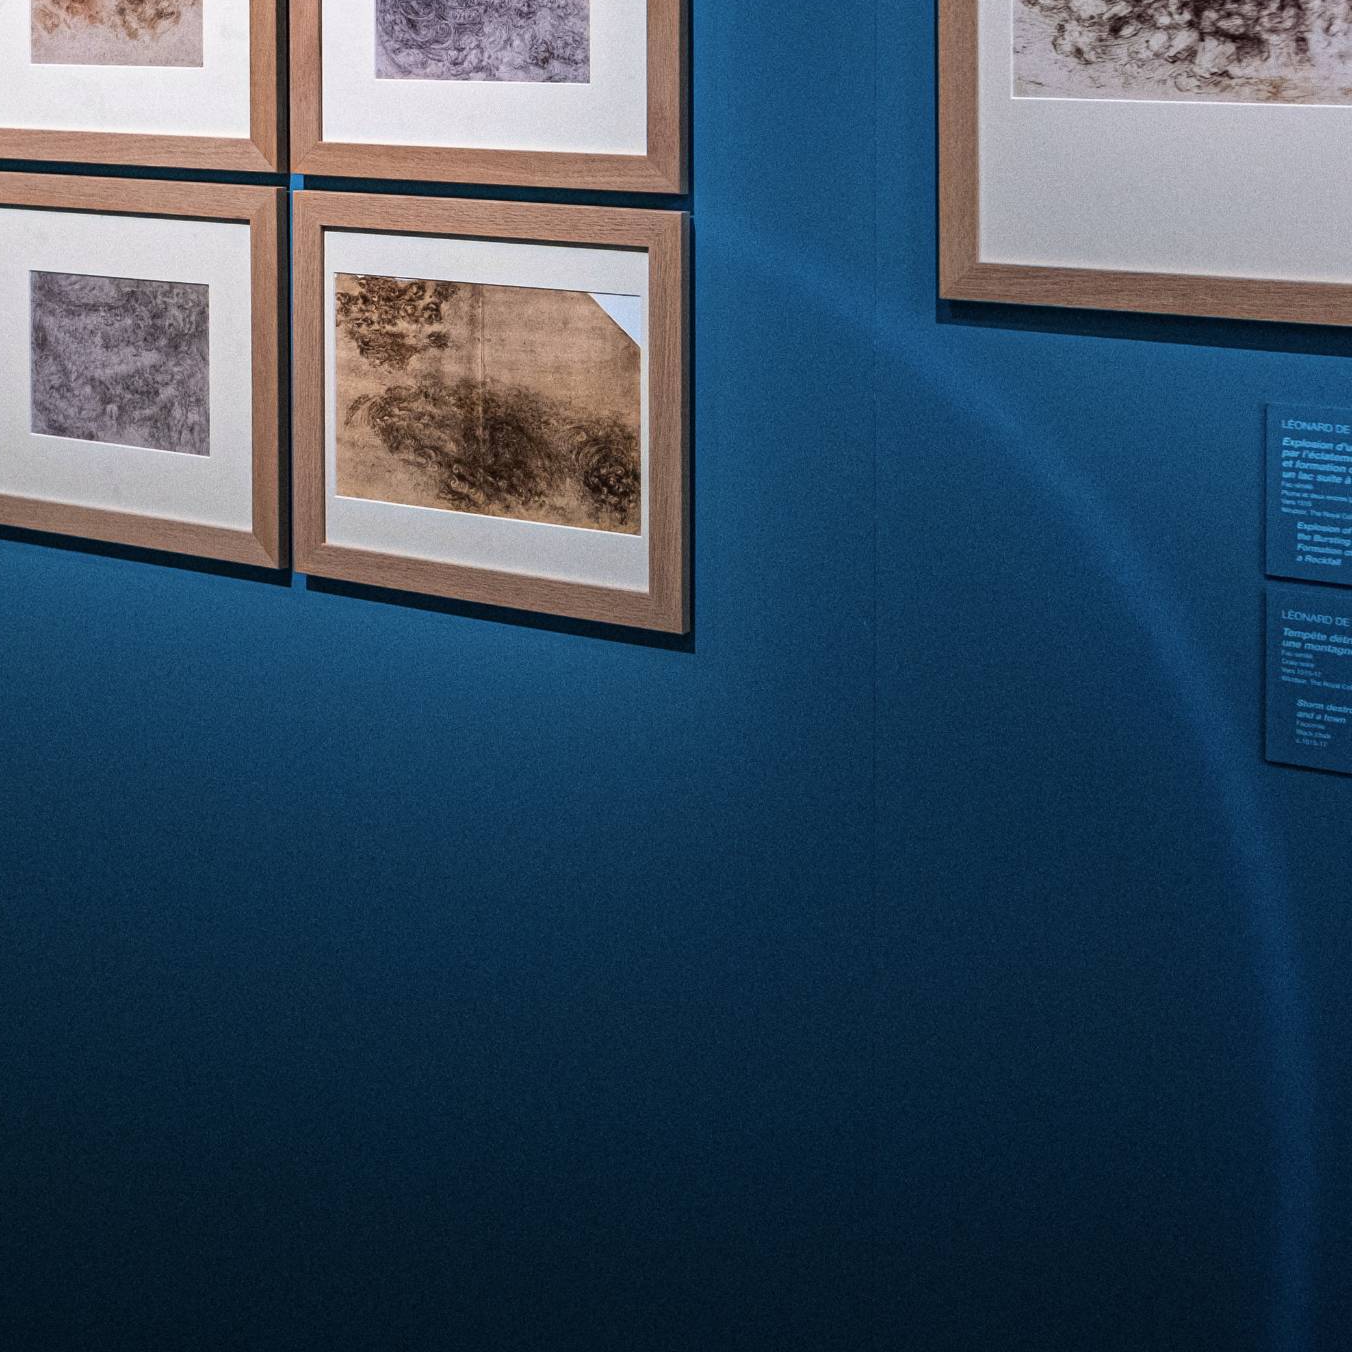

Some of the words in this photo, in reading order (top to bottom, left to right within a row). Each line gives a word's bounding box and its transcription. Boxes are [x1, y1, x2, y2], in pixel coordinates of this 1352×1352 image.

[1335, 424, 1350, 434] DE
[1282, 437, 1333, 450] Explosion
[1281, 450, 1300, 458] par
[1295, 460, 1347, 473] formation
[1282, 471, 1296, 479] un
[1298, 471, 1315, 480] lac
[1316, 474, 1343, 484] suite
[1335, 616, 1350, 627] DE
[1282, 640, 1302, 649] une
